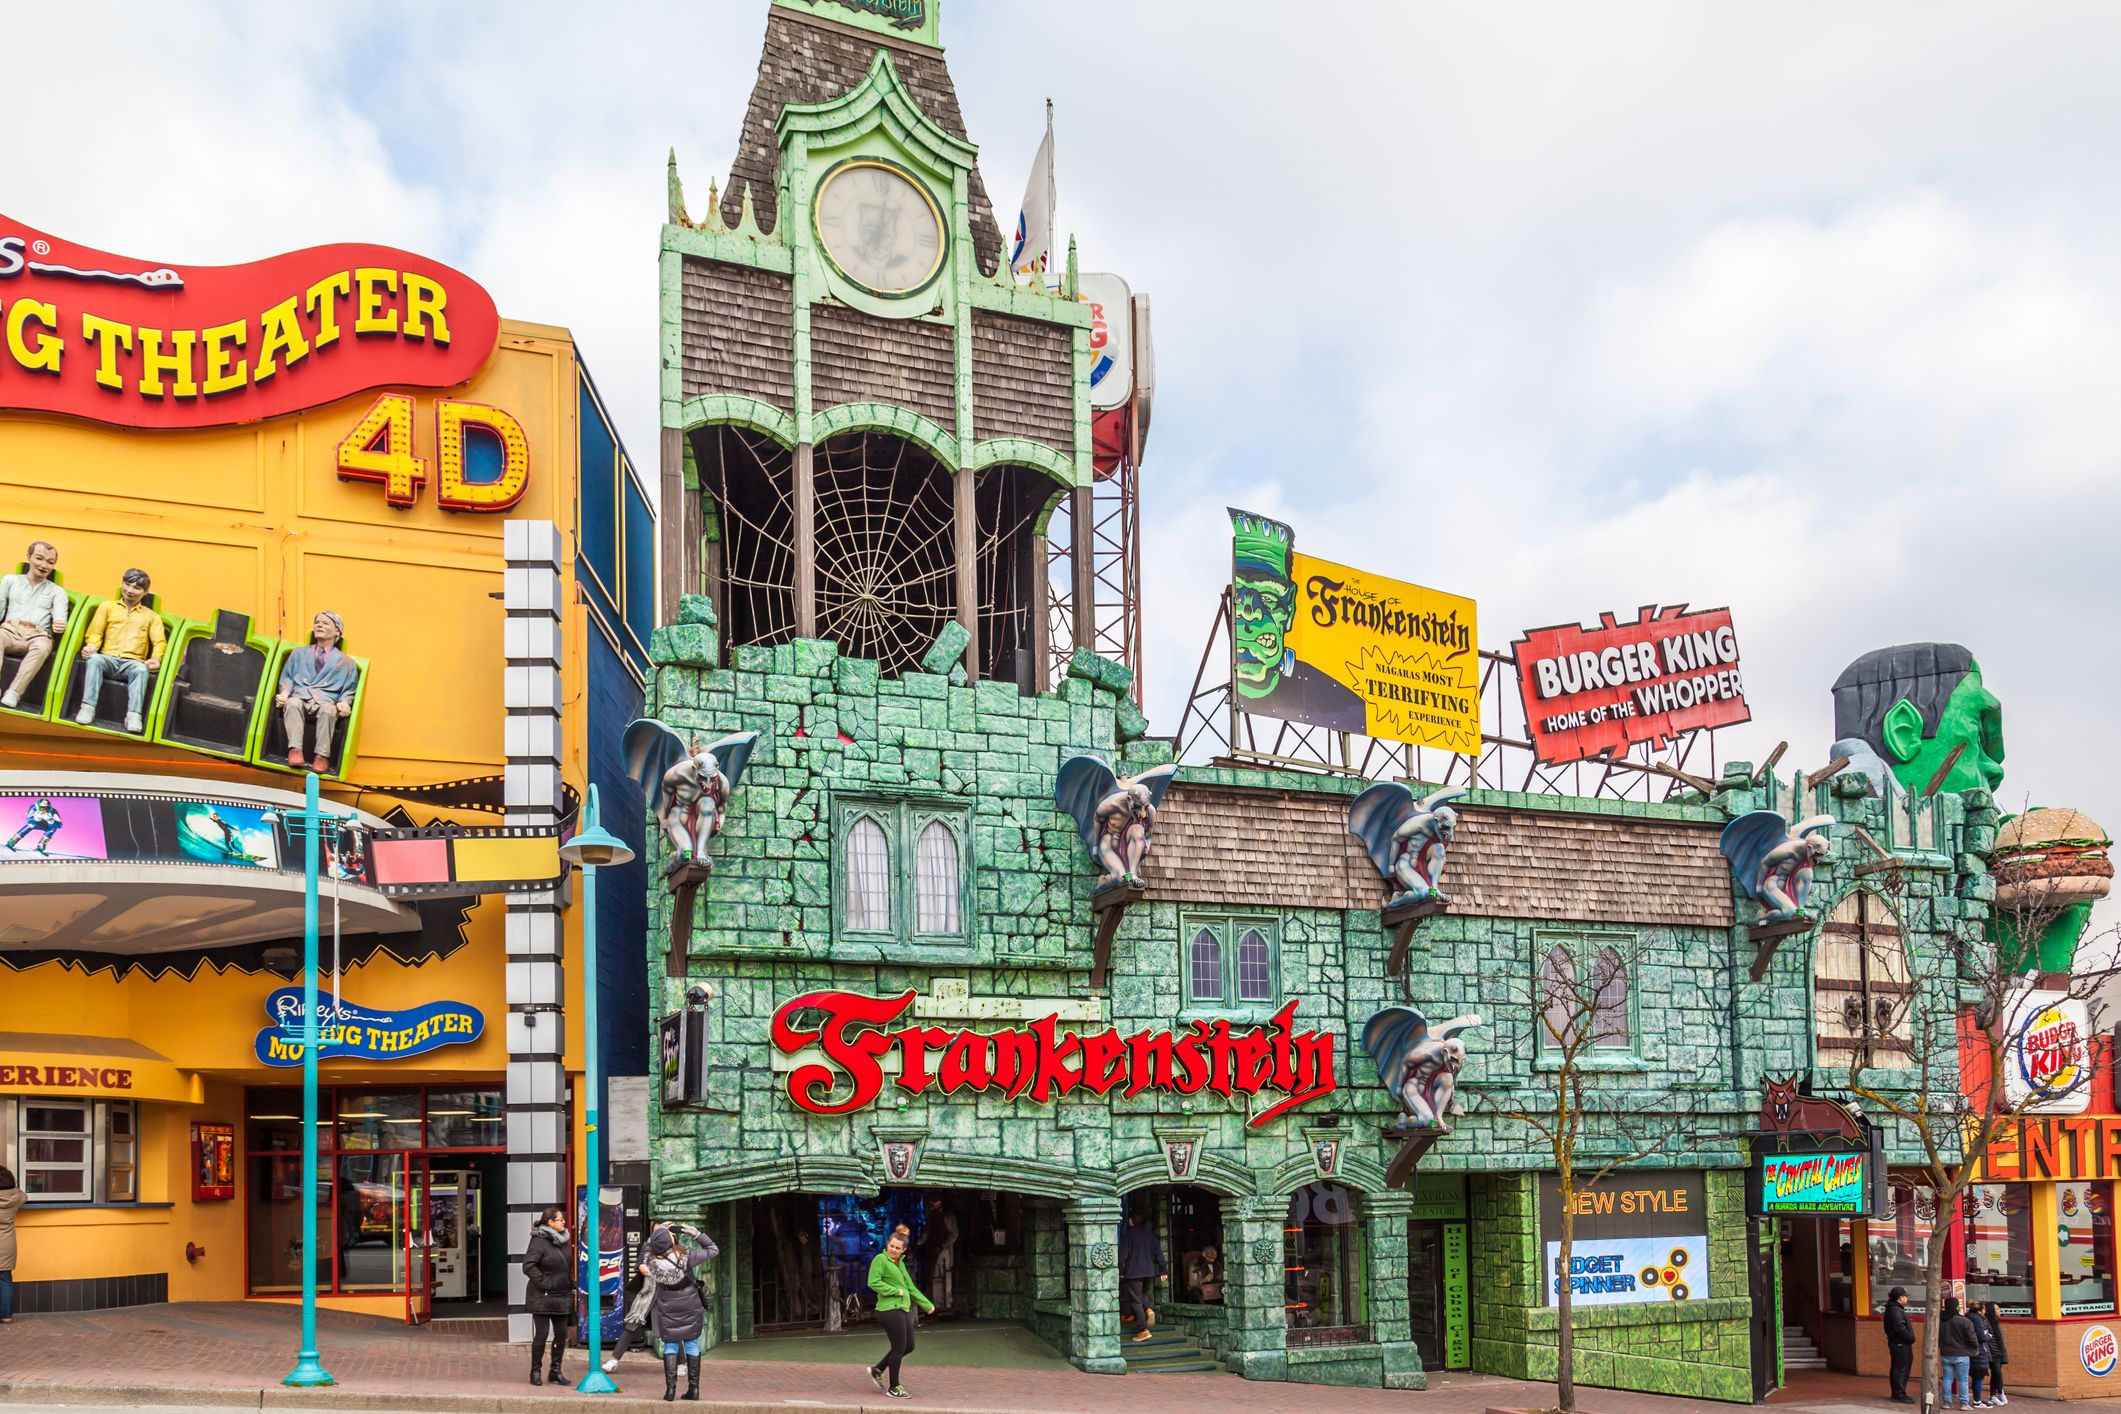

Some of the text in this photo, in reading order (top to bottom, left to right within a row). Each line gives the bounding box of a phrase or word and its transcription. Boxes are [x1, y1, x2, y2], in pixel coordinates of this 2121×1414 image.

[82, 267, 451, 399] THEATER
[336, 393, 531, 512] 4D
[1344, 584, 1401, 605] HOUSE OF
[1306, 575, 1471, 662] Frankenstein
[1375, 662, 1453, 687] NIAGARAS MOST
[1533, 626, 1739, 699] BURGER KING
[1365, 678, 1469, 714] TERRIFYING
[1546, 669, 1744, 733] HOME OF THE WHOPPER
[1408, 710, 1462, 729] EXPERIENCE
[268, 1013, 473, 1060] MOING THEATER
[2027, 1021, 2082, 1079] BURGER KING
[771, 988, 1337, 1127] Frankenstein
[1776, 1158, 1824, 1198] CRYSTAL
[1824, 1154, 1863, 1194] CAVES
[1620, 1189, 1688, 1213] STYLE
[1774, 1202, 1797, 1210] MIRROR
[1799, 1202, 1816, 1210] MAZE
[1817, 1202, 1855, 1211] ADVENTURE
[579, 1251, 622, 1269] PPSI
[1554, 1254, 1624, 1275] DGET
[2065, 1304, 2113, 1312] ENTRANCE
[2084, 1334, 2113, 1354] BURGER
[2086, 1343, 2115, 1367] KING
